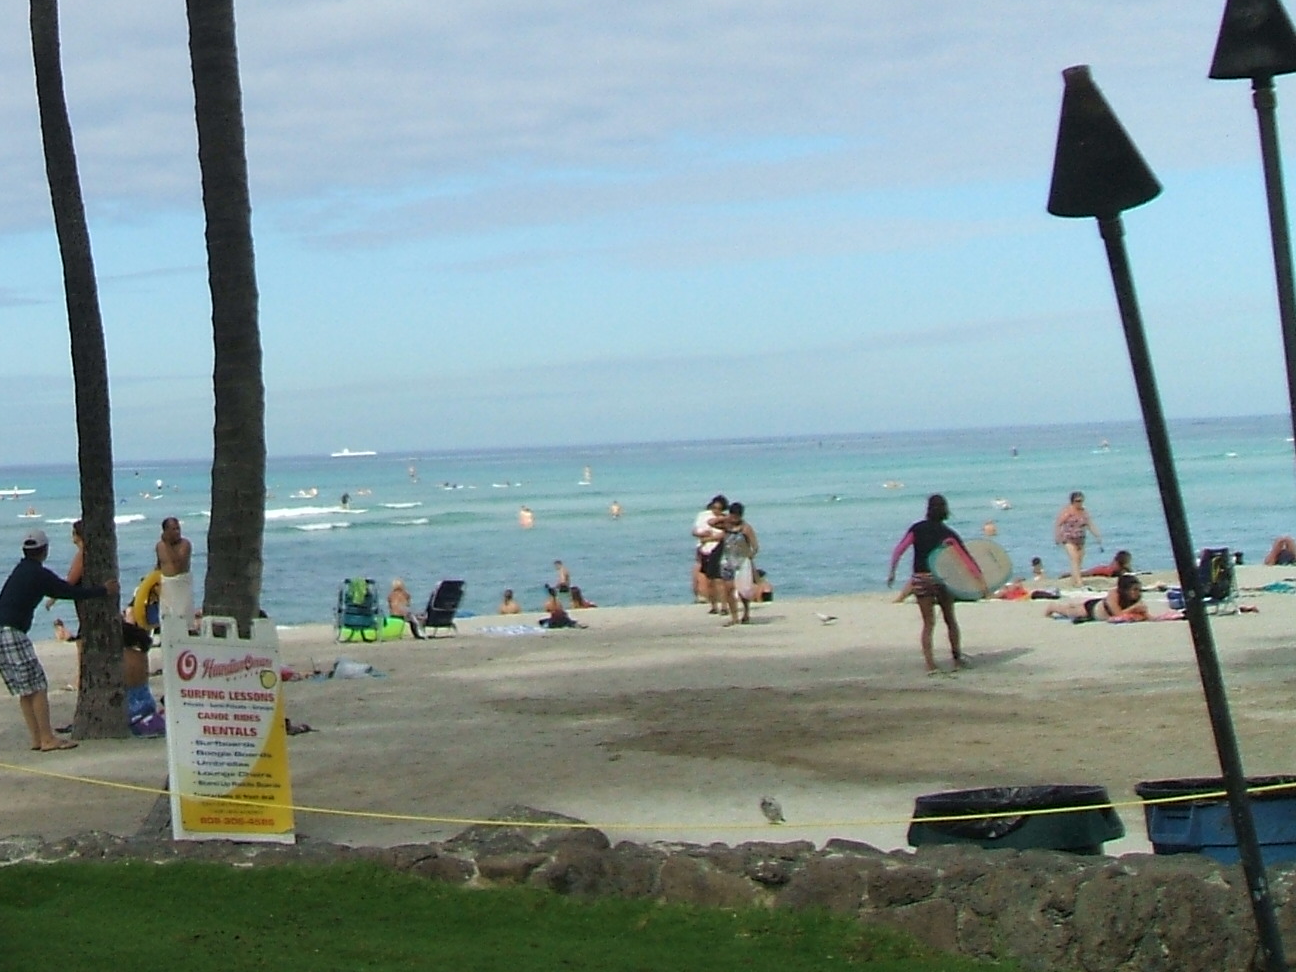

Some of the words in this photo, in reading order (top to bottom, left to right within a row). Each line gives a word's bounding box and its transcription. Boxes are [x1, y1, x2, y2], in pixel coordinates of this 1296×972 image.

[181, 689, 225, 700] SURFING
[229, 691, 274, 702] LESSONS
[198, 712, 229, 720] CANOE
[234, 714, 261, 722] RIDES
[203, 725, 257, 737] RENTALS
